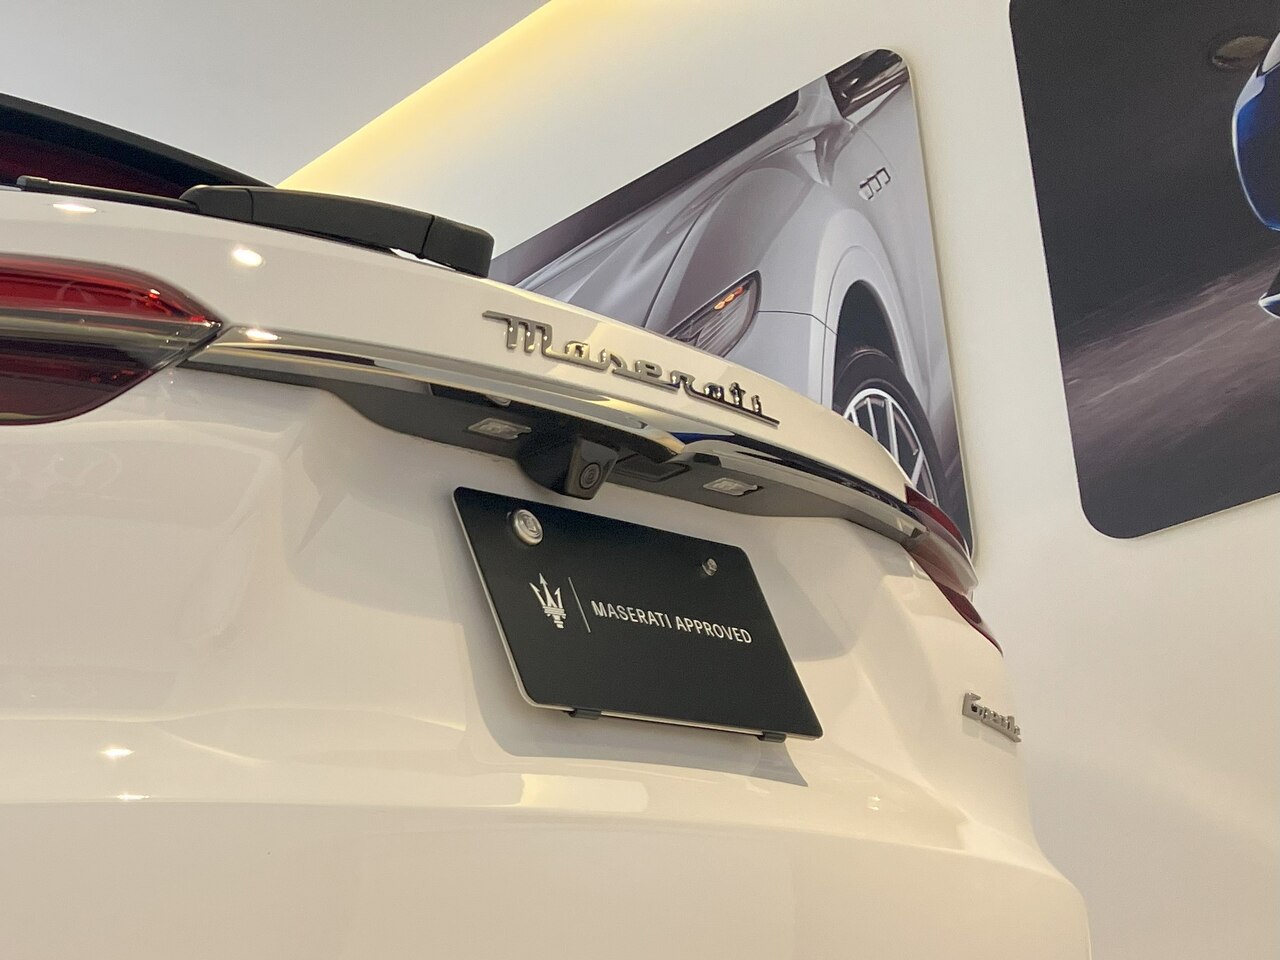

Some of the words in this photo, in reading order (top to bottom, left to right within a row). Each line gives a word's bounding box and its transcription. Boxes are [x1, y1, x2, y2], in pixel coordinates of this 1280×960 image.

[482, 310, 780, 428] Maserati
[591, 600, 672, 629] MASERATI
[675, 616, 752, 644] APPROVED
